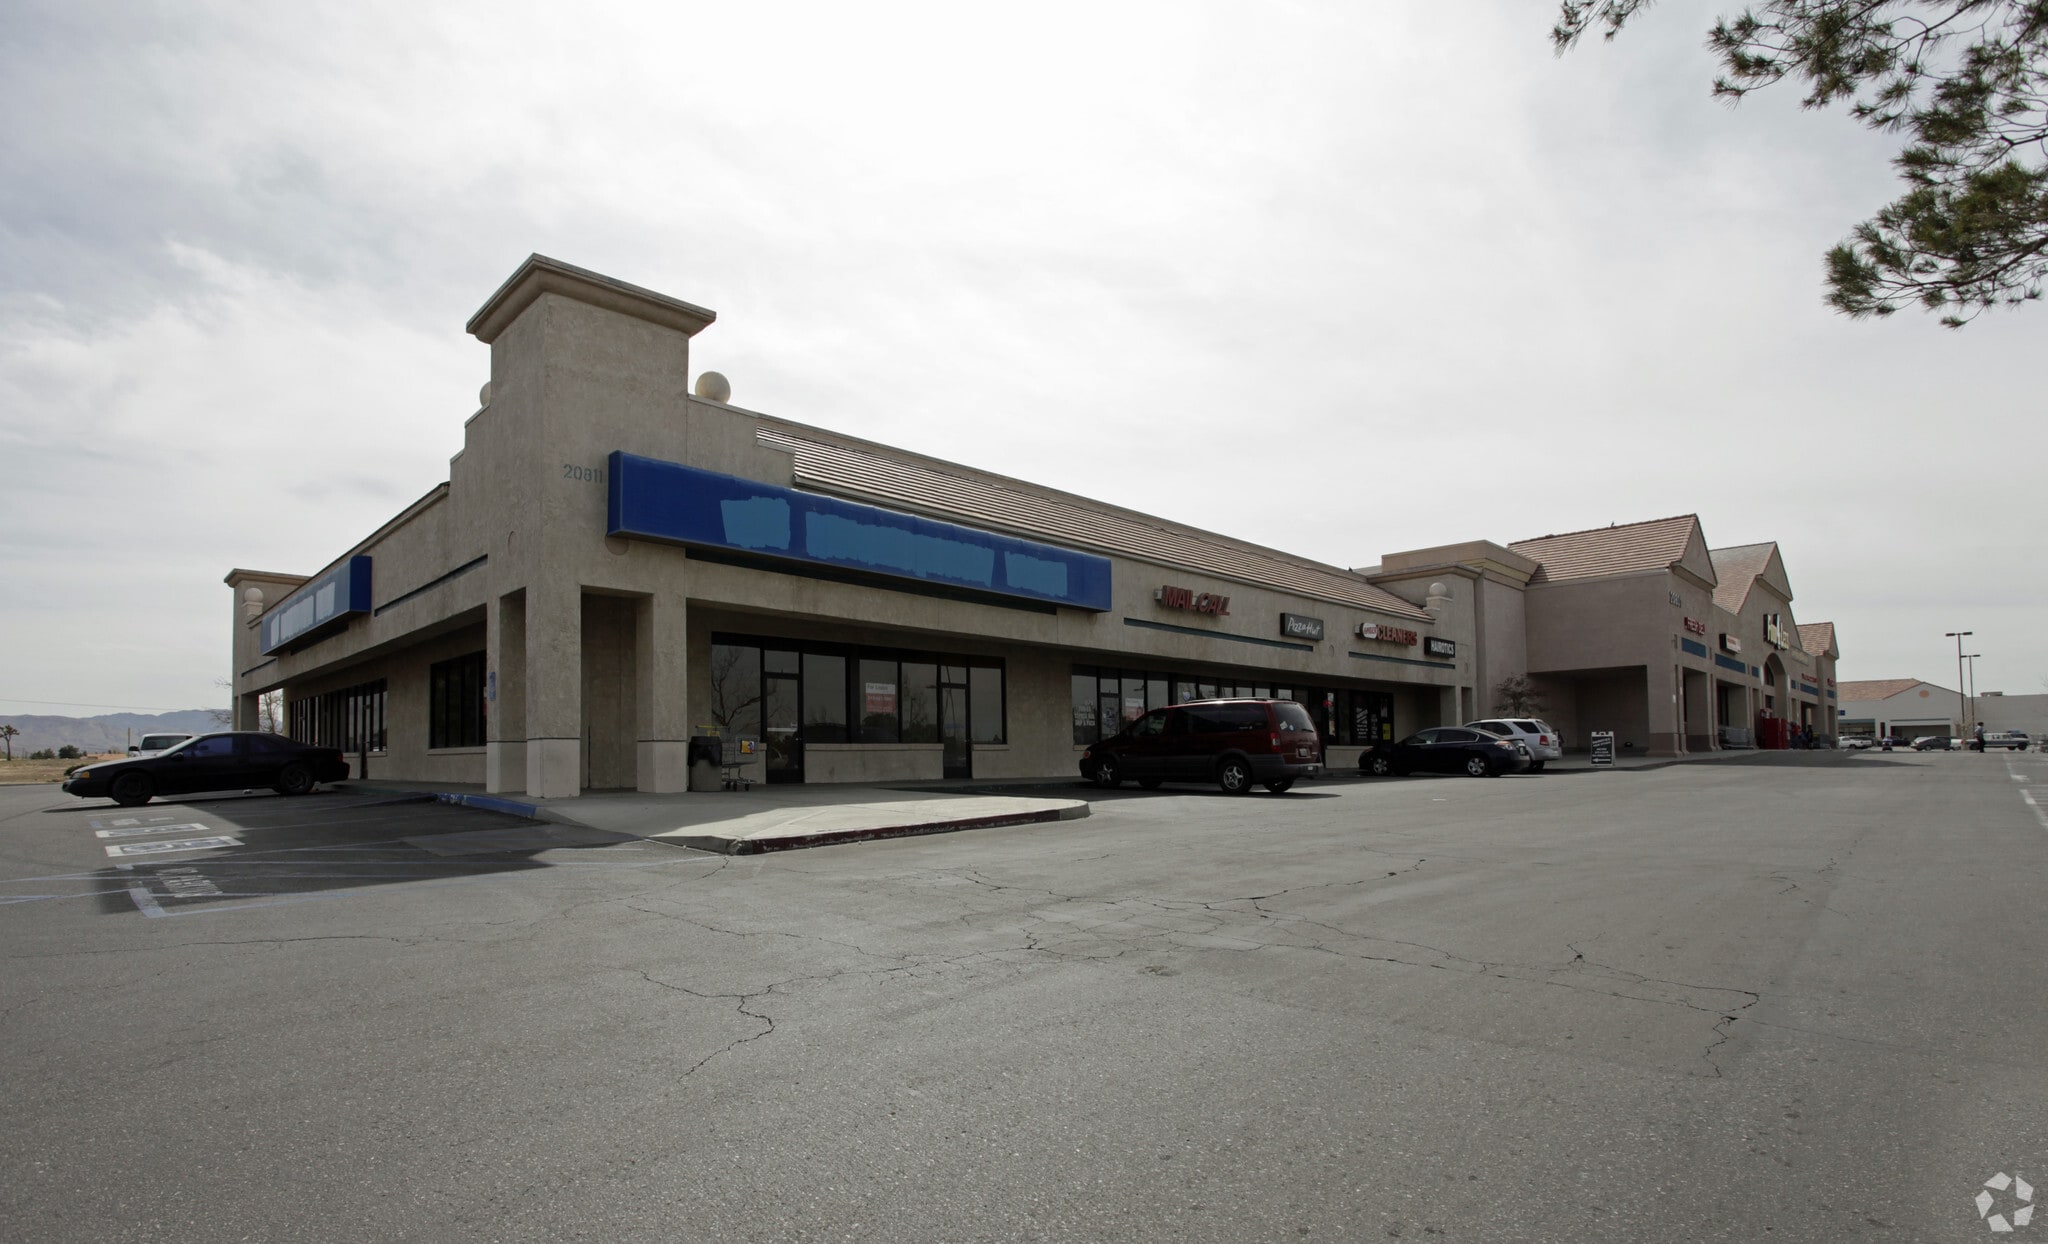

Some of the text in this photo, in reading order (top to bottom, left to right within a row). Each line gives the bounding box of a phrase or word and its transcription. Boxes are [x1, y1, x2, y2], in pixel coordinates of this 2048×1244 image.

[1164, 585, 1230, 616] MAIL CALL
[1287, 616, 1321, 635] Pizza Hut
[1377, 624, 1418, 646] CLEANERS
